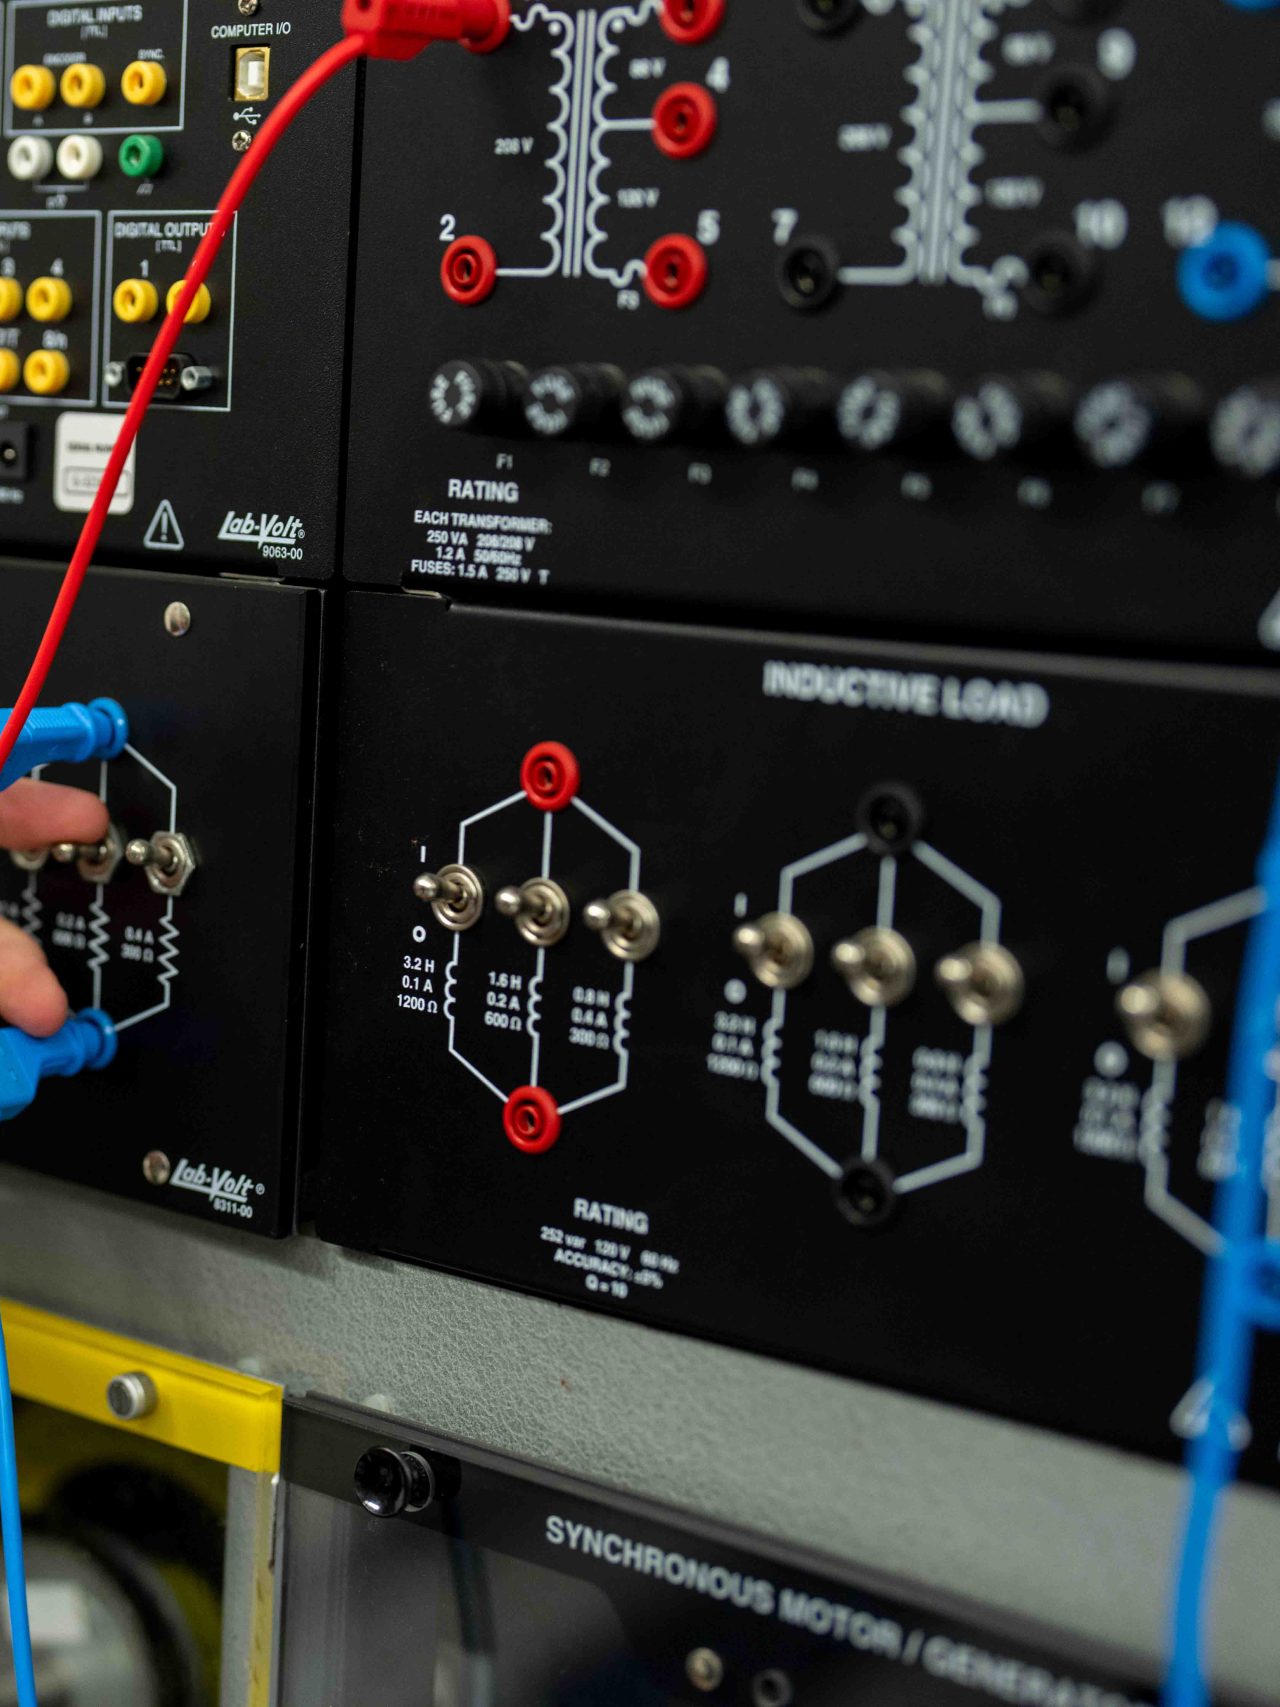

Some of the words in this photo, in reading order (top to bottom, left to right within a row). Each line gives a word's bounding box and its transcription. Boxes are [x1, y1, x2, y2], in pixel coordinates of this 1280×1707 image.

[47, 9, 95, 28] DIGITAL
[96, 5, 143, 23] INPUTS
[211, 23, 273, 39] COMPUTER
[276, 21, 291, 35] I/O
[705, 56, 731, 94] 4
[521, 136, 535, 154] V
[114, 221, 163, 238] DIGITAL
[439, 213, 456, 241] 2
[696, 209, 720, 245] 5
[771, 207, 799, 246] 7
[50, 257, 64, 276] 4
[140, 259, 149, 278] 1
[495, 453, 513, 470] F1
[448, 478, 519, 503] RATING
[414, 510, 449, 525] EACH
[451, 512, 552, 534] TRANSFORMER:
[427, 530, 448, 544] 250
[450, 531, 468, 546] VA
[524, 536, 535, 552] V
[262, 545, 303, 560] 9063-00
[436, 546, 454, 560] 1.2
[455, 547, 466, 561] A
[411, 559, 455, 575] FUSES:
[458, 563, 475, 578] 1.5
[477, 565, 488, 579] A
[496, 566, 519, 583] 250
[521, 568, 532, 584] V
[538, 569, 550, 585] T
[763, 660, 941, 717] INDUCTIVE
[942, 675, 1049, 729] LOAD
[143, 929, 154, 944] A
[403, 955, 422, 971] 3.2
[424, 958, 435, 974] H
[402, 974, 419, 991] 0.1
[423, 979, 433, 994] A
[488, 971, 508, 988] 1.6
[510, 974, 522, 991] H
[397, 993, 425, 1011] 1200
[427, 999, 438, 1014] Ω
[486, 991, 507, 1009] 0.2
[508, 995, 520, 1012] A
[484, 1010, 509, 1028] 600
[510, 1015, 522, 1031] Ω
[594, 1010, 608, 1030] A
[213, 1197, 253, 1218] 8311-00
[573, 1197, 649, 1235] RATING
[540, 1225, 564, 1245] 252
[553, 1247, 634, 1282] ACCURACY:
[585, 1273, 599, 1292] Q
[546, 1515, 775, 1615] SYNCHRONOUS
[778, 1588, 903, 1660] MOTOR
